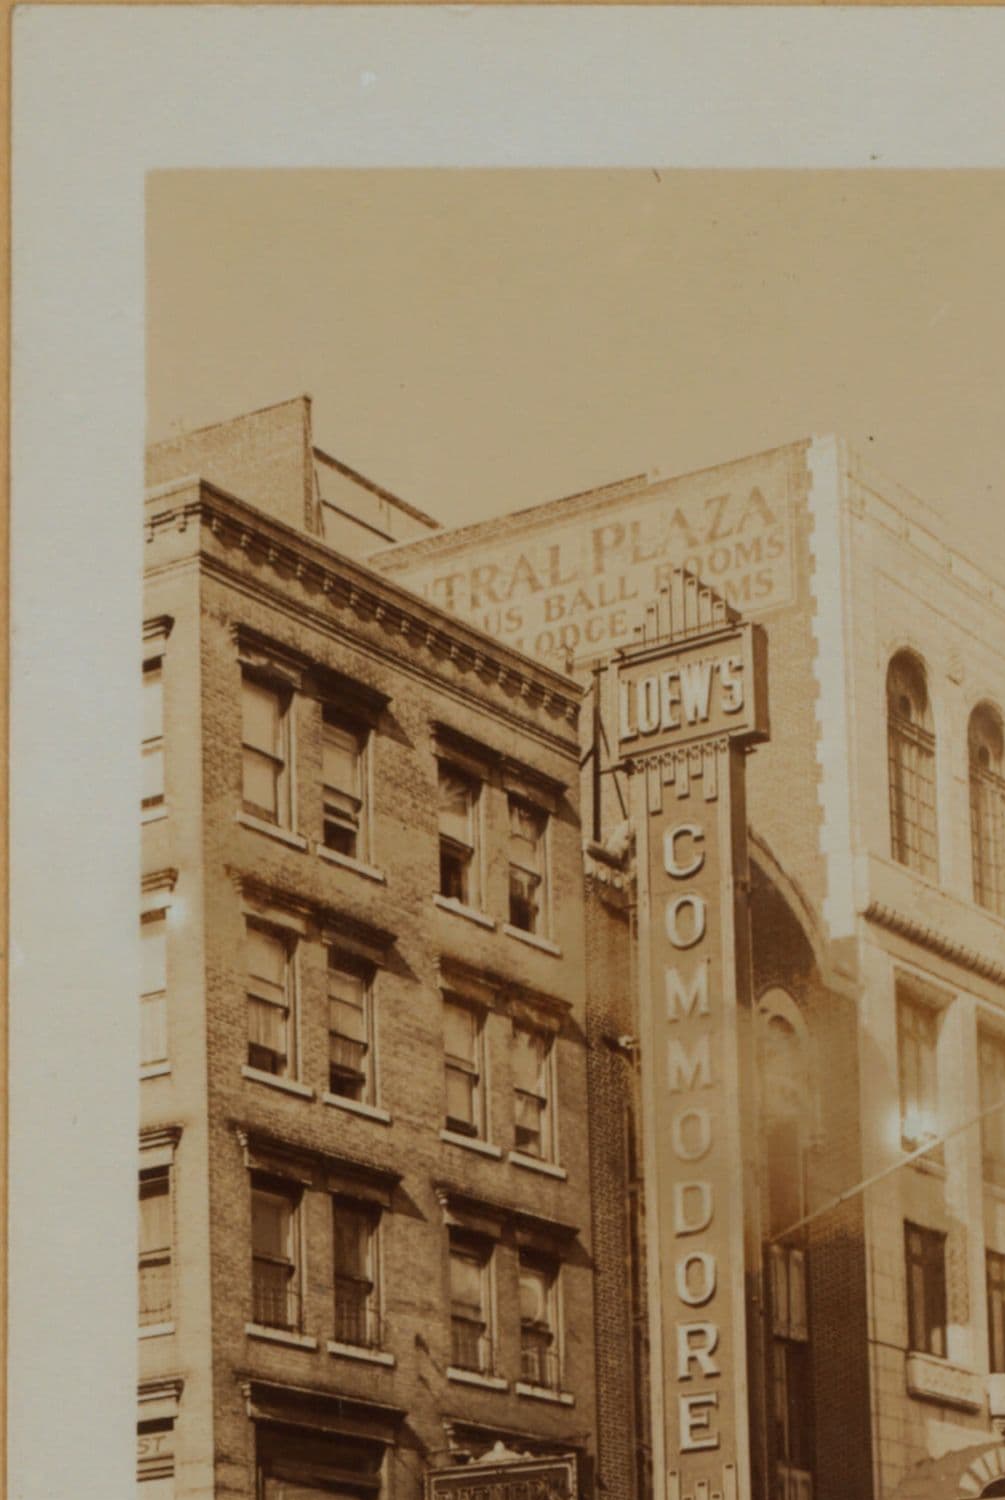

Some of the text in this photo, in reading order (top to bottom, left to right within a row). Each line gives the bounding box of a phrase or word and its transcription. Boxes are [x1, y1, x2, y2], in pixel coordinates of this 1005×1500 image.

[424, 485, 777, 610] TRAL PLAZA
[545, 576, 638, 622] BALL
[616, 657, 745, 744] LOEW'S
[662, 828, 721, 1456] COMMODORE
